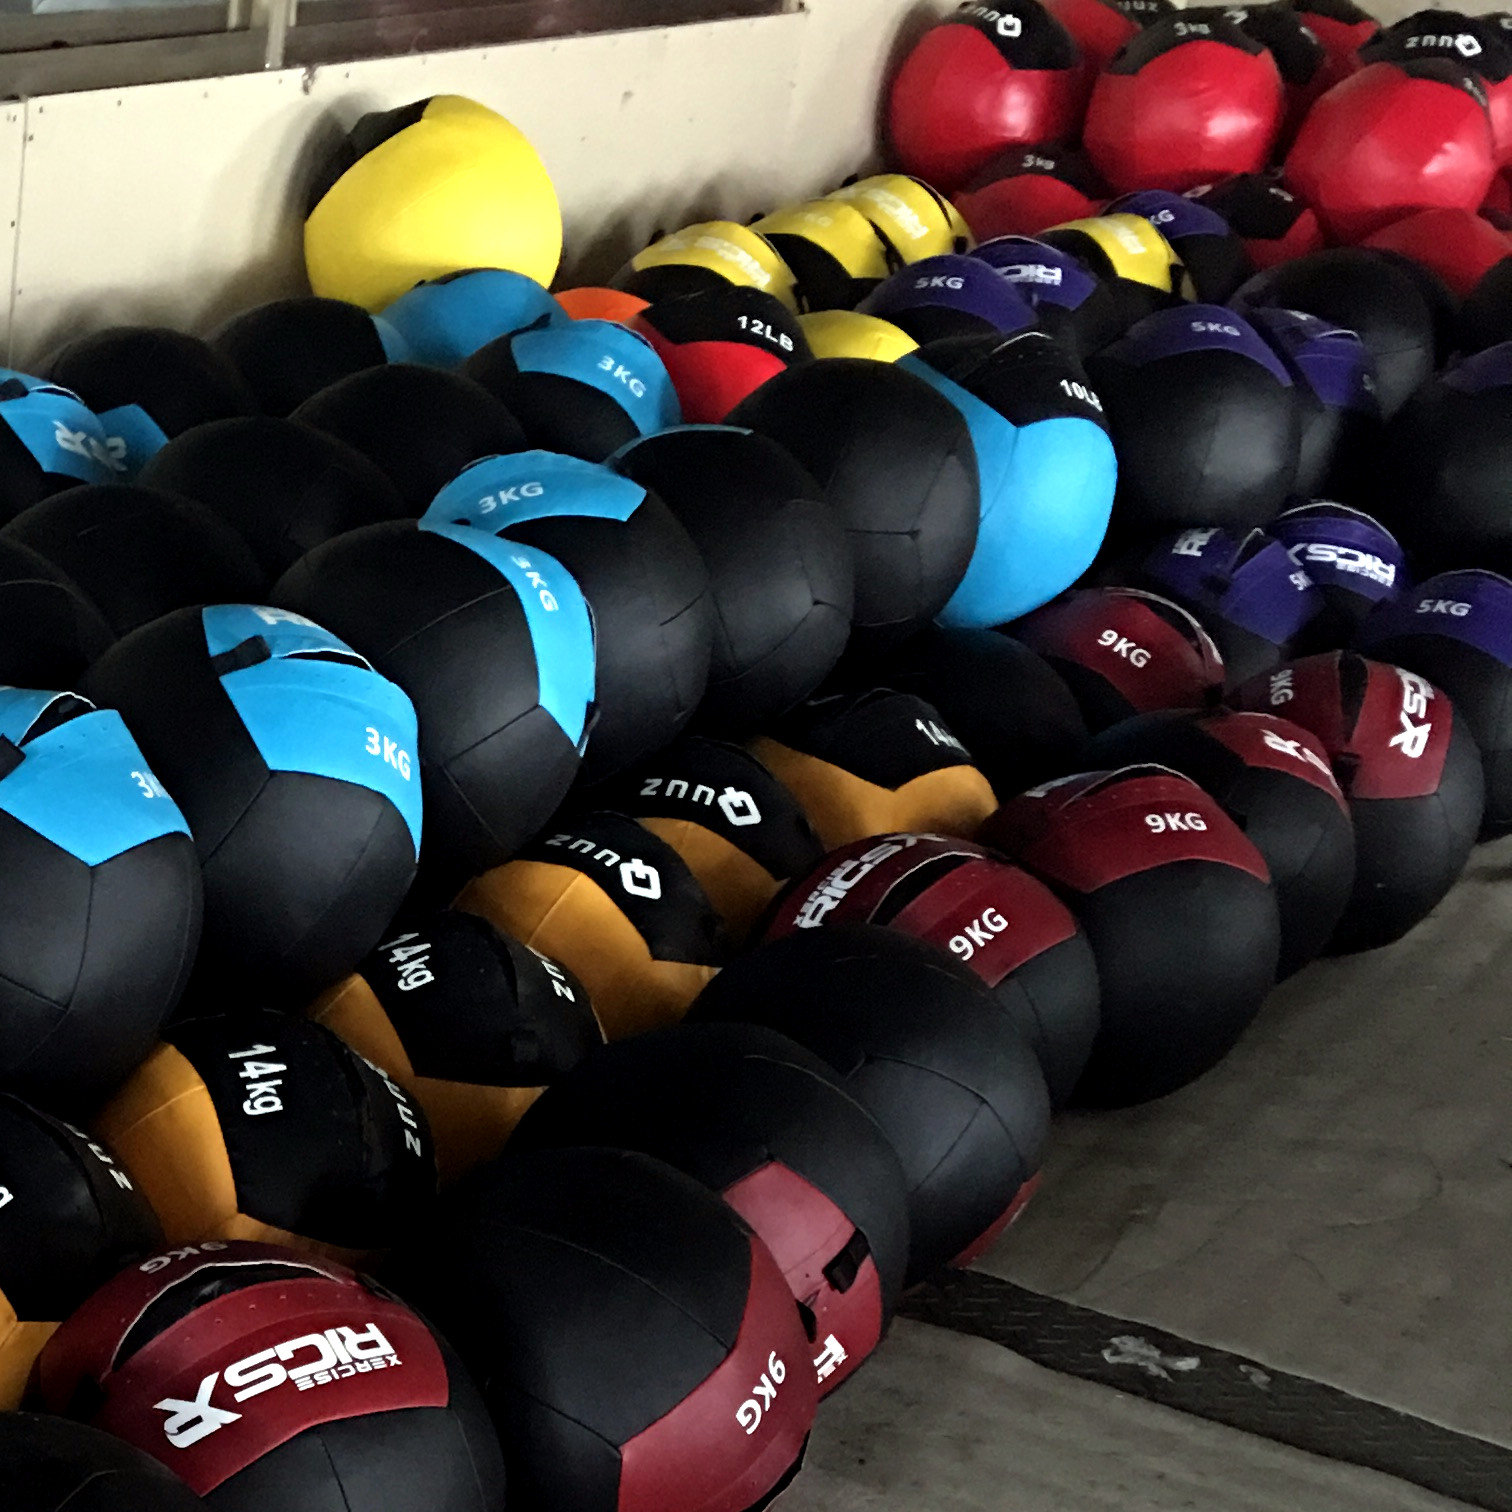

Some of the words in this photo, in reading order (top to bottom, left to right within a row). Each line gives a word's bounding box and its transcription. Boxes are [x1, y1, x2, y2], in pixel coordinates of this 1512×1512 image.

[1147, 209, 1175, 225] KG
[914, 276, 965, 290] 5KG
[737, 315, 794, 352] 12LB
[597, 355, 647, 398] 3KG
[478, 481, 544, 514] 3KG
[511, 555, 559, 611] 3KG
[1416, 599, 1472, 617] 5KG
[1097, 629, 1152, 668] 9KG
[365, 726, 411, 782] 3KG
[1145, 812, 1208, 833] 9KG
[948, 907, 1009, 961] 9KG
[378, 932, 435, 991] 14kg
[228, 1044, 288, 1116] 14kg
[294, 1353, 403, 1392] XERCISE
[735, 1350, 786, 1436] 9KG
